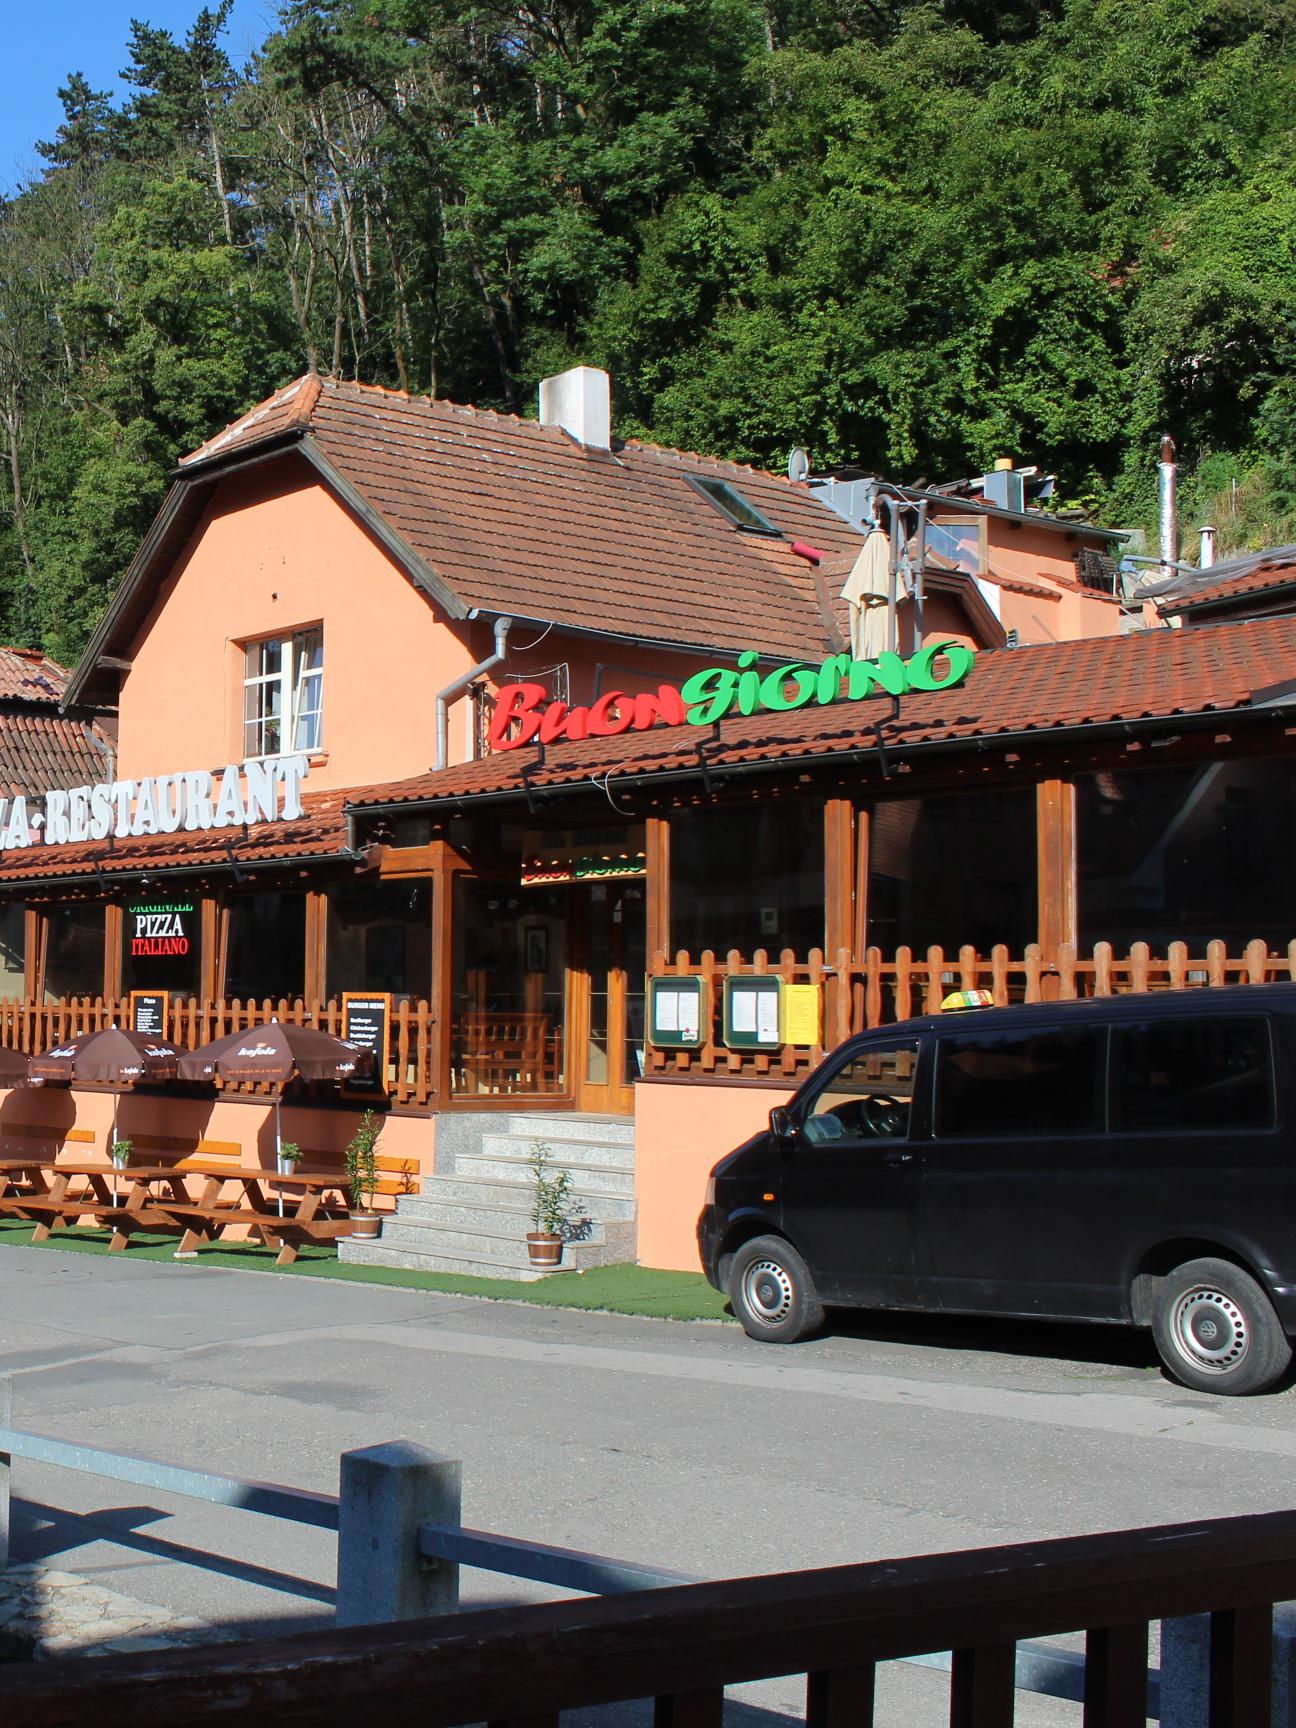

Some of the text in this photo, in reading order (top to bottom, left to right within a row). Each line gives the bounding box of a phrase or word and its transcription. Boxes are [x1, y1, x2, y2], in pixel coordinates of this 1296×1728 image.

[44, 755, 310, 846] RESTAURANT
[135, 913, 184, 938] PIZZA
[130, 938, 189, 955] ITALIANO
[238, 1047, 277, 1057] kofola
